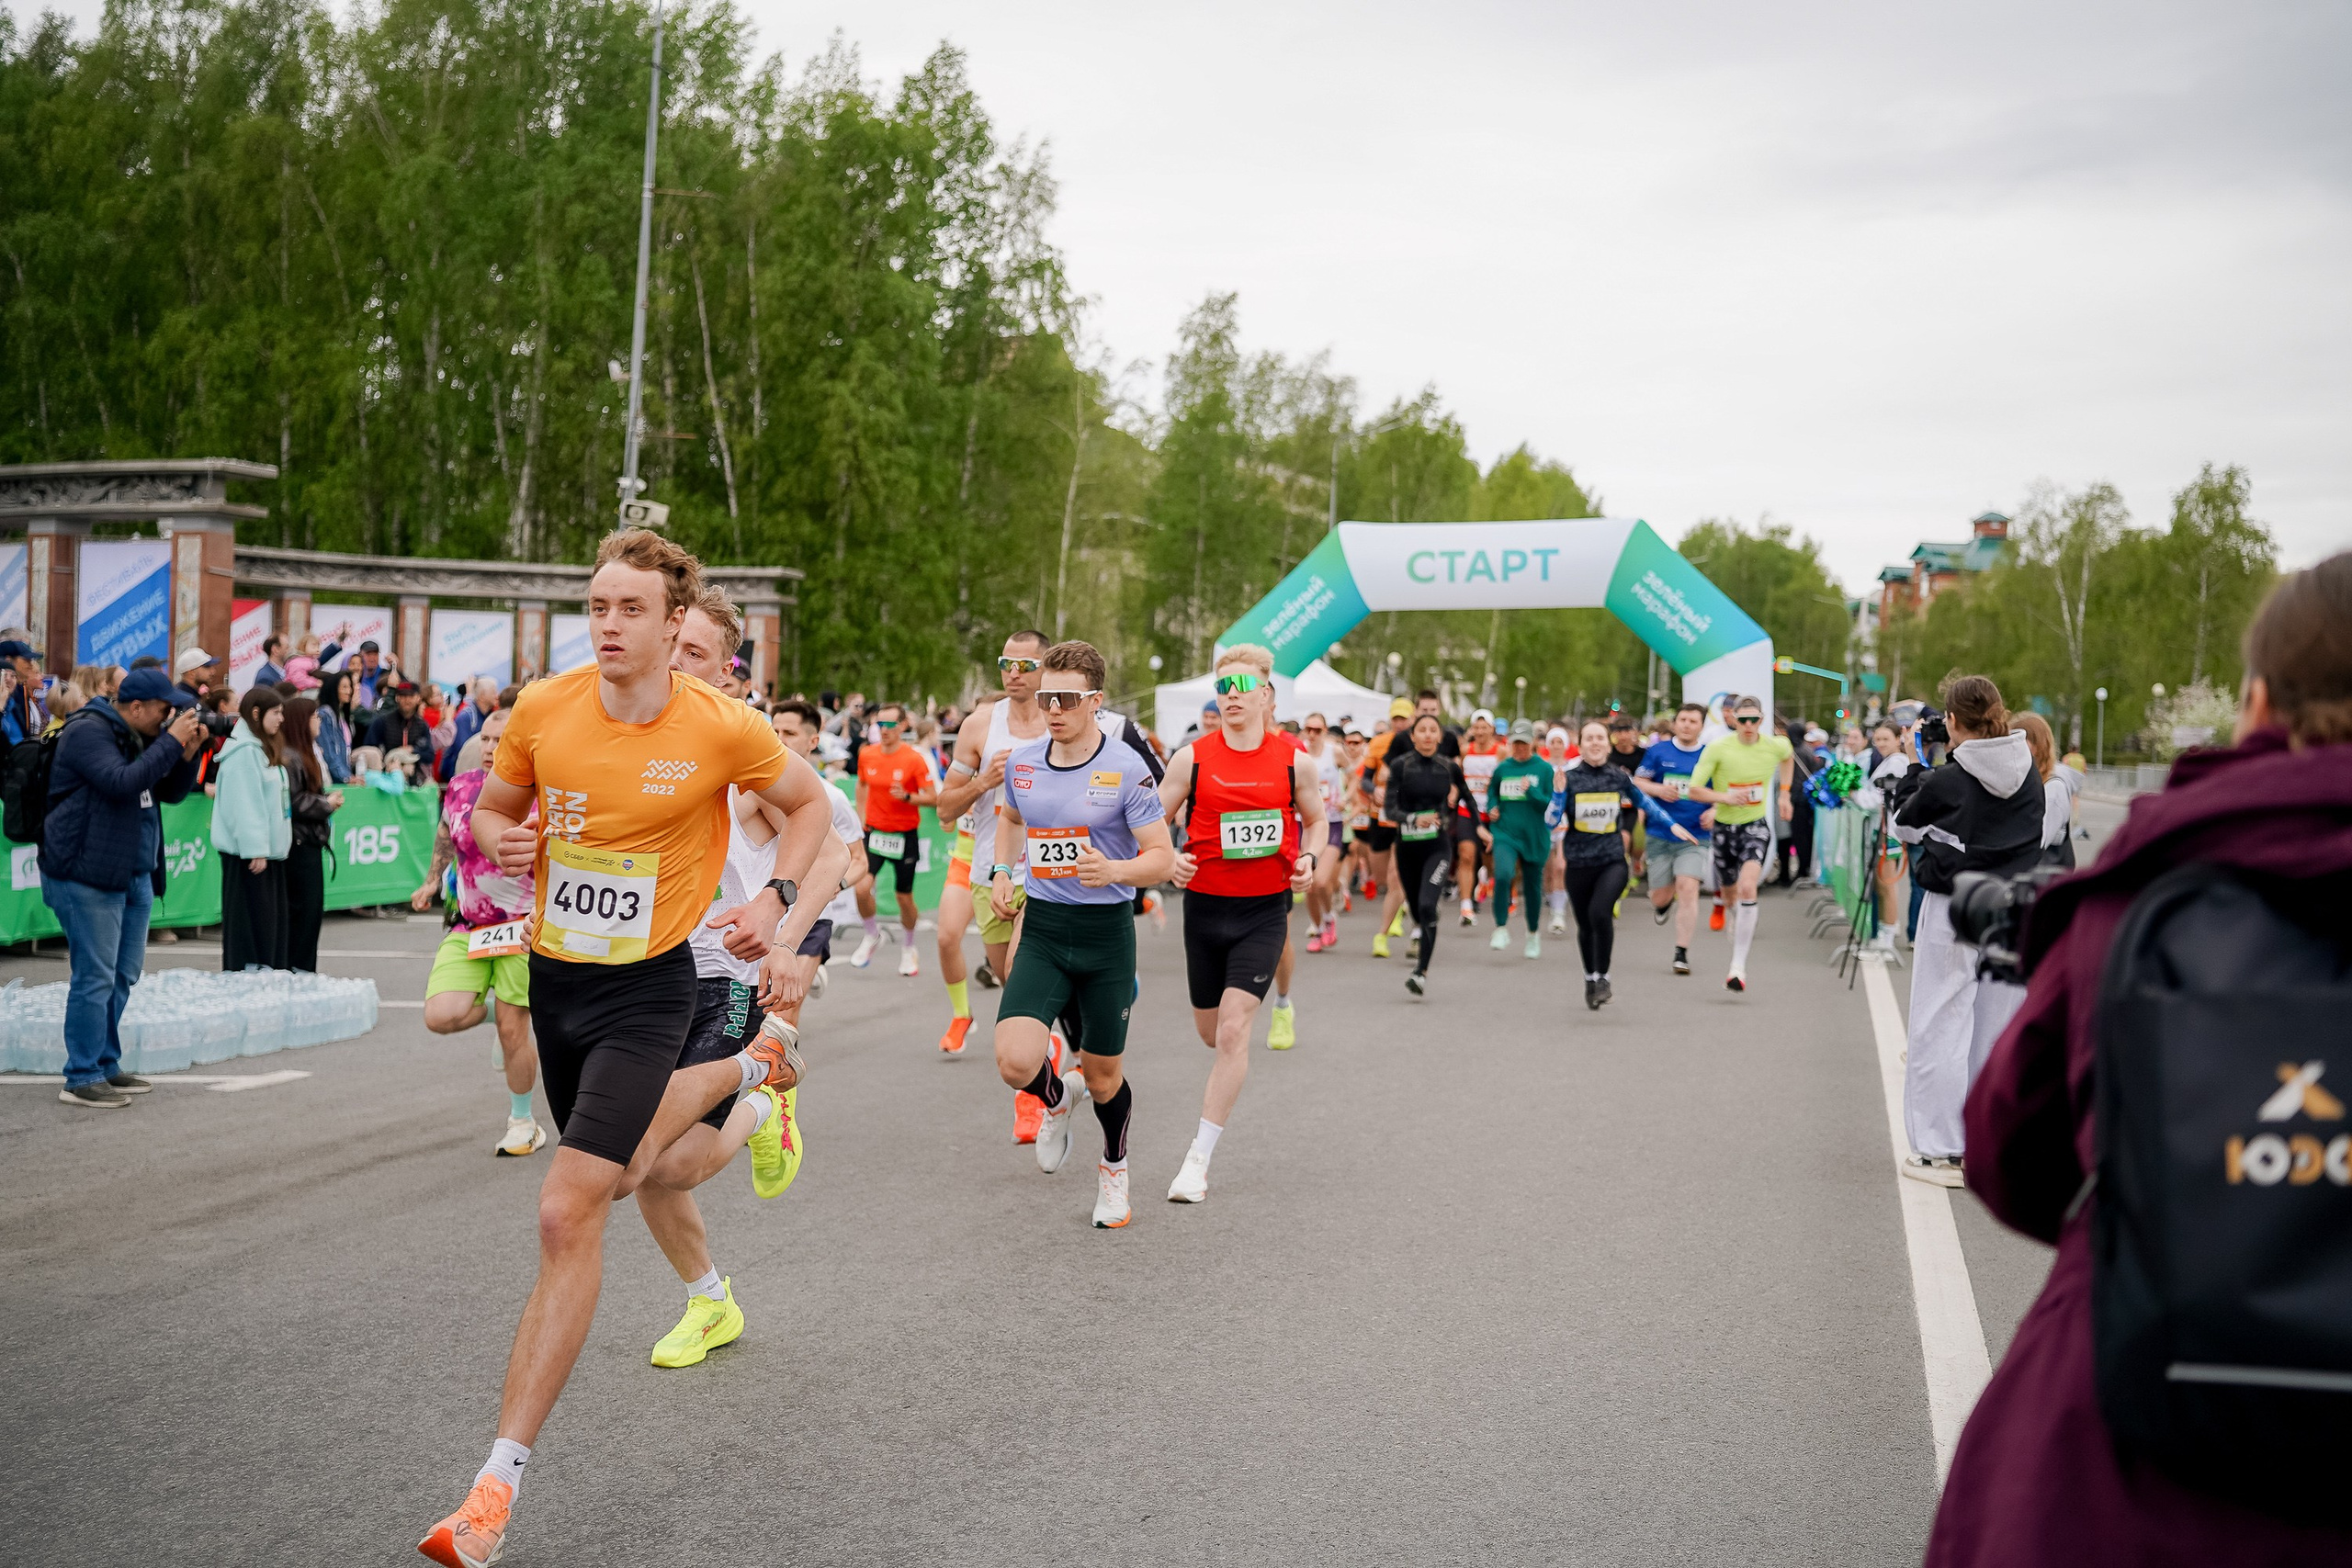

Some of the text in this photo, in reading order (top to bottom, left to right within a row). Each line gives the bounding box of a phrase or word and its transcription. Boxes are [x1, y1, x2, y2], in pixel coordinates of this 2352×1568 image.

[1407, 548, 1560, 583] СТАРТ
[1261, 575, 1326, 639] зелёный
[1272, 589, 1336, 651] марафон
[1630, 581, 1698, 646] марафон
[1643, 570, 1713, 634] зелёный
[641, 783, 675, 795] 2022
[344, 825, 401, 866] 185
[1039, 841, 1079, 863] 233
[1227, 824, 1277, 844] 1392
[553, 880, 641, 922] 4003
[481, 926, 514, 945] 241
